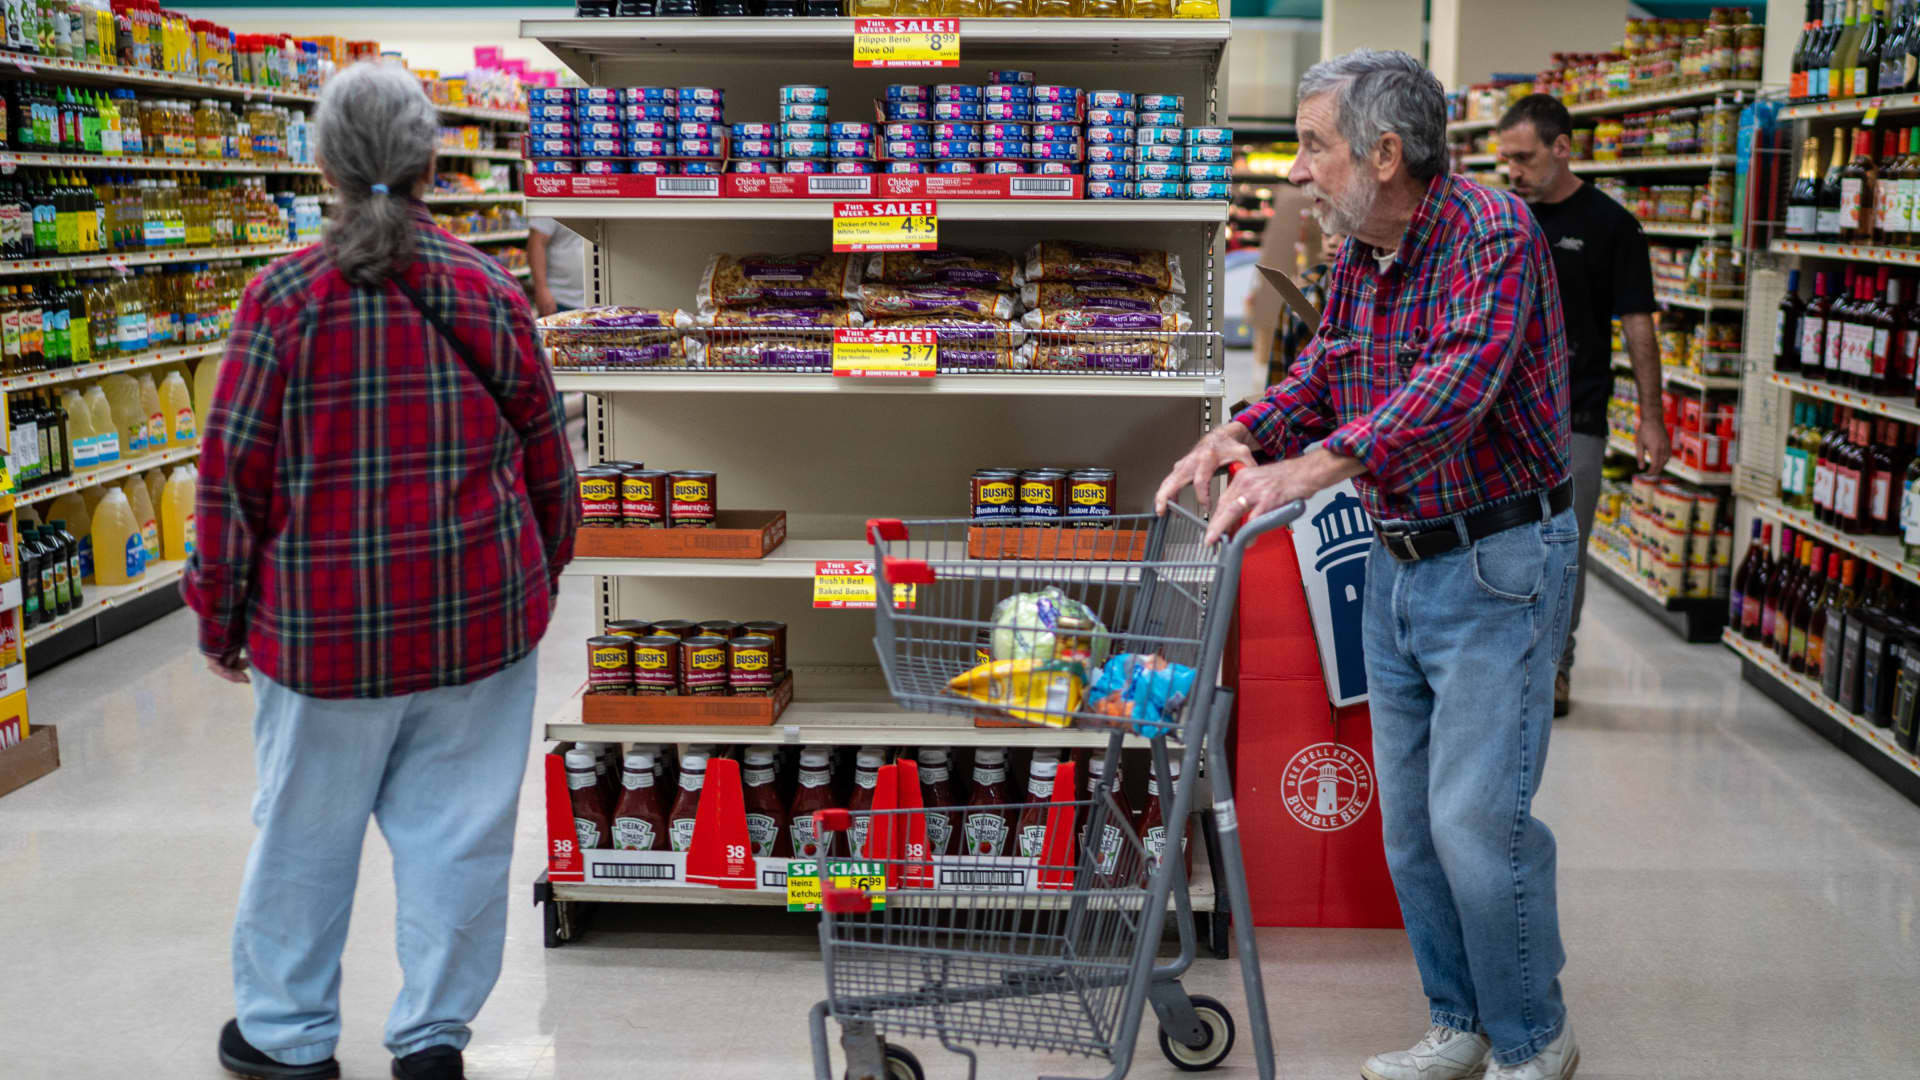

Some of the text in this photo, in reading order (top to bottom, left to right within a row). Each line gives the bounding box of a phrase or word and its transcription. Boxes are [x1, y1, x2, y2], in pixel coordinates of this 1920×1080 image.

[894, 20, 955, 33] SALE!
[858, 35, 911, 44] Filippo Berio
[858, 46, 895, 54] Olive Oil
[533, 177, 566, 187] Chicken
[735, 177, 766, 187] Chicken
[887, 177, 919, 188] Chicken
[542, 185, 560, 194] Sea
[743, 184, 760, 193] Sea
[895, 185, 913, 194] Sea
[872, 203, 932, 215] SALE!
[901, 216, 914, 233] 4
[872, 331, 932, 343] SALE!
[901, 345, 912, 361] 3
[583, 484, 613, 495] BUSH'S
[623, 484, 651, 496] BUSH'S
[675, 484, 707, 496] BUSH'S
[982, 487, 1013, 498] BUSH'S
[1021, 487, 1051, 499] BUSH'S
[1073, 488, 1105, 499] BUSH'S
[672, 503, 711, 512] Homestyle
[976, 505, 1018, 514] Boston Recip
[1035, 505, 1059, 516] Recipe
[1089, 506, 1111, 516] Recipe
[819, 576, 844, 584] Bush's
[595, 653, 626, 663] BUSH'S
[637, 653, 665, 665] BUSH'S
[695, 654, 725, 665] BUSH'S
[736, 654, 767, 665] BUSH'S
[1287, 749, 1368, 789] BEE WELL FOR LIFE
[1287, 795, 1365, 827] BUMBLE BEE
[621, 822, 645, 832] HEINZ
[680, 823, 693, 831] HEI
[975, 818, 1000, 829] HEINZ
[621, 832, 644, 840] TOMATO
[553, 839, 572, 852] 38
[726, 844, 745, 858] 38
[792, 863, 880, 876] SPCIAL!
[791, 879, 812, 887] Heinz
